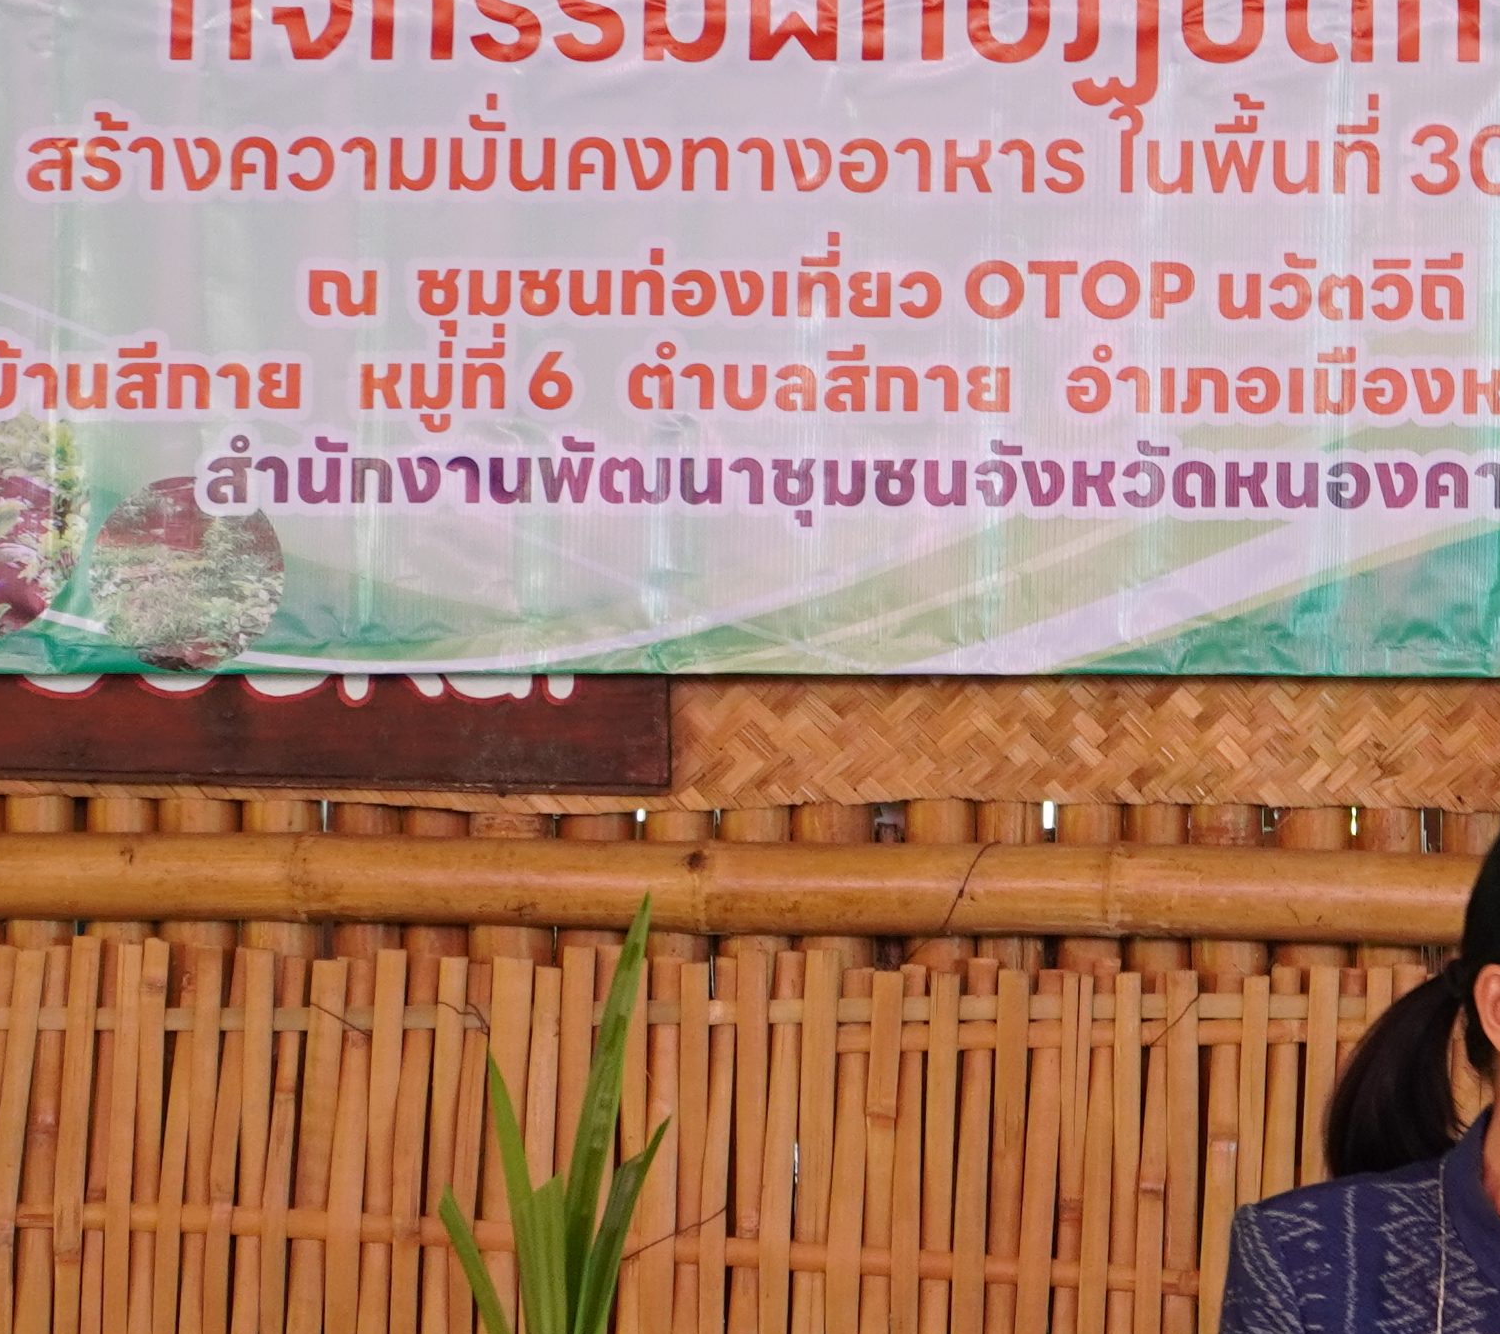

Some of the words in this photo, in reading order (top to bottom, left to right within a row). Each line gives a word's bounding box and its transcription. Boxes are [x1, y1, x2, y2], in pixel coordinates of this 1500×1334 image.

[26, 93, 1085, 194] สร้างความมั่นคงทางอาหาร
[1110, 93, 1381, 195] ในพื้นที่
[308, 267, 377, 317] ณ
[417, 232, 943, 338] ชุมชนท่องเที่ยว
[964, 260, 1197, 322] OTOP
[1218, 252, 1465, 323] นวัตวิถี
[360, 323, 506, 433] หมู่ที่
[528, 351, 574, 412] 6
[627, 342, 1010, 414] ตำบลสีกาย
